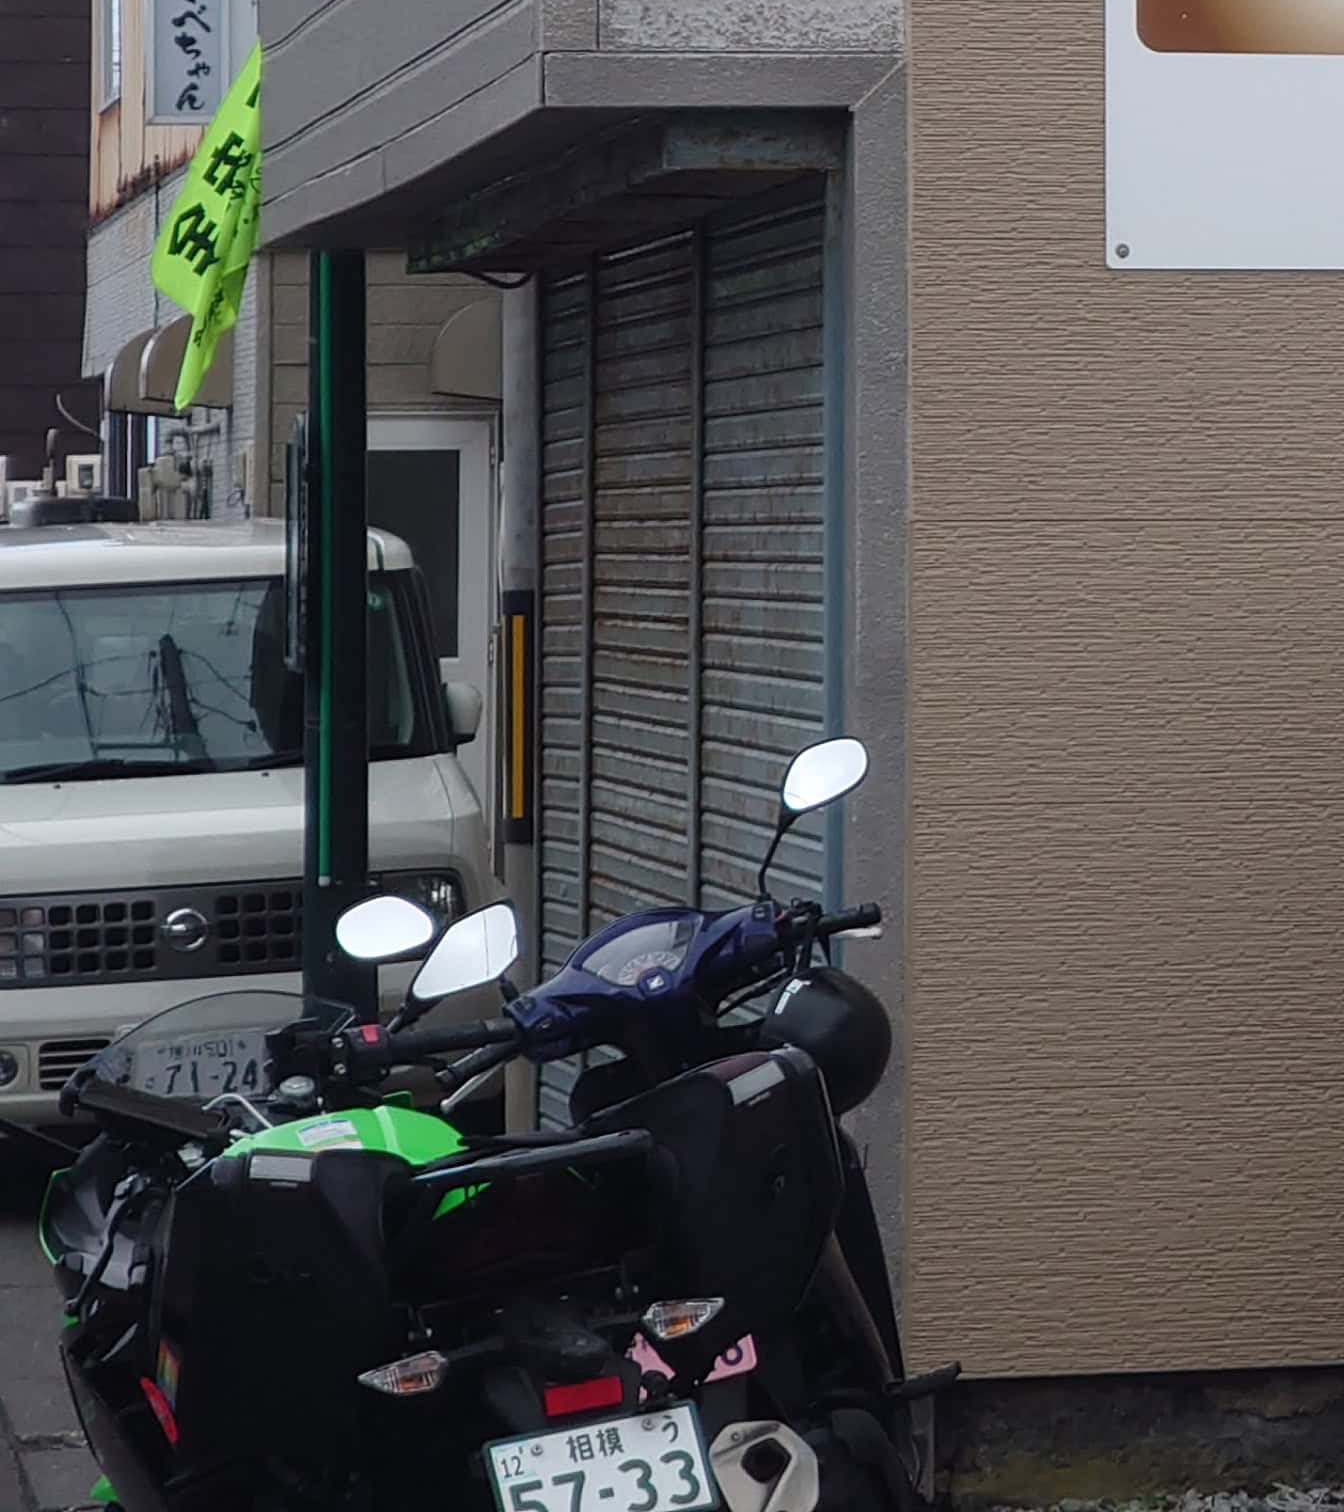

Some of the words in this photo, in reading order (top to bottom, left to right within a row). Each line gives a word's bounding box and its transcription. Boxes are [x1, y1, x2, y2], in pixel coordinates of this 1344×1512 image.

[164, 1058, 258, 1095] 71-24
[566, 1427, 624, 1463] 相模
[509, 1450, 701, 1512] 57-33
